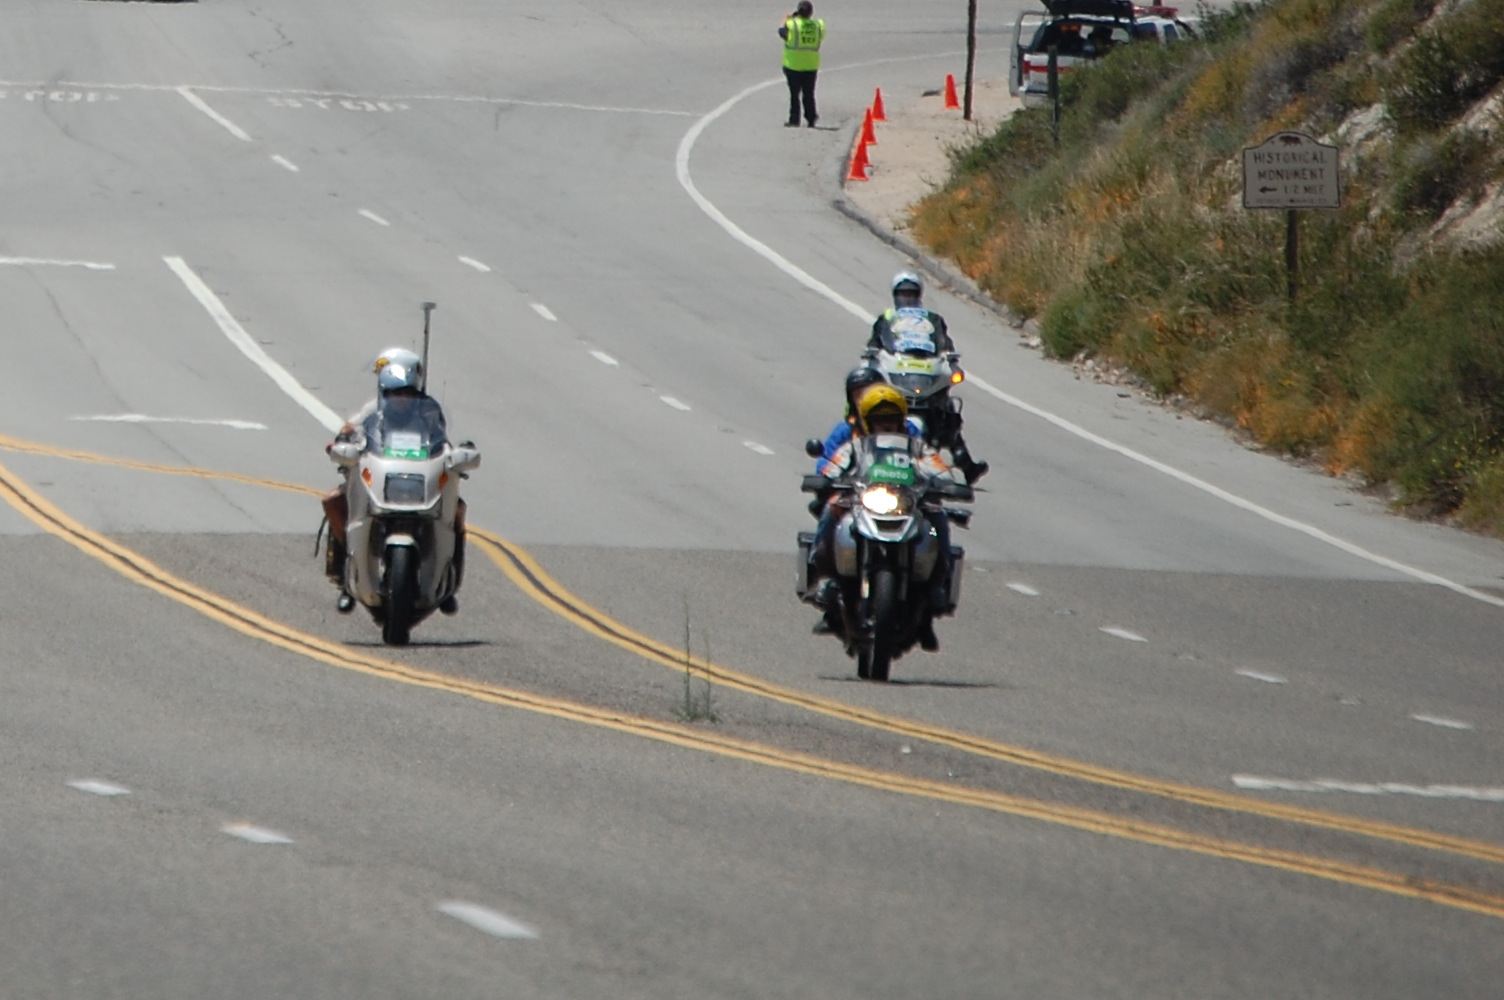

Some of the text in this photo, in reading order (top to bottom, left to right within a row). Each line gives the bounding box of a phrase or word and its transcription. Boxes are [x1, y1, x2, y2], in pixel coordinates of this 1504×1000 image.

[1253, 151, 1328, 164] HISTORICAL
[1257, 168, 1326, 180] MONUMENT
[873, 468, 909, 481] Photo
